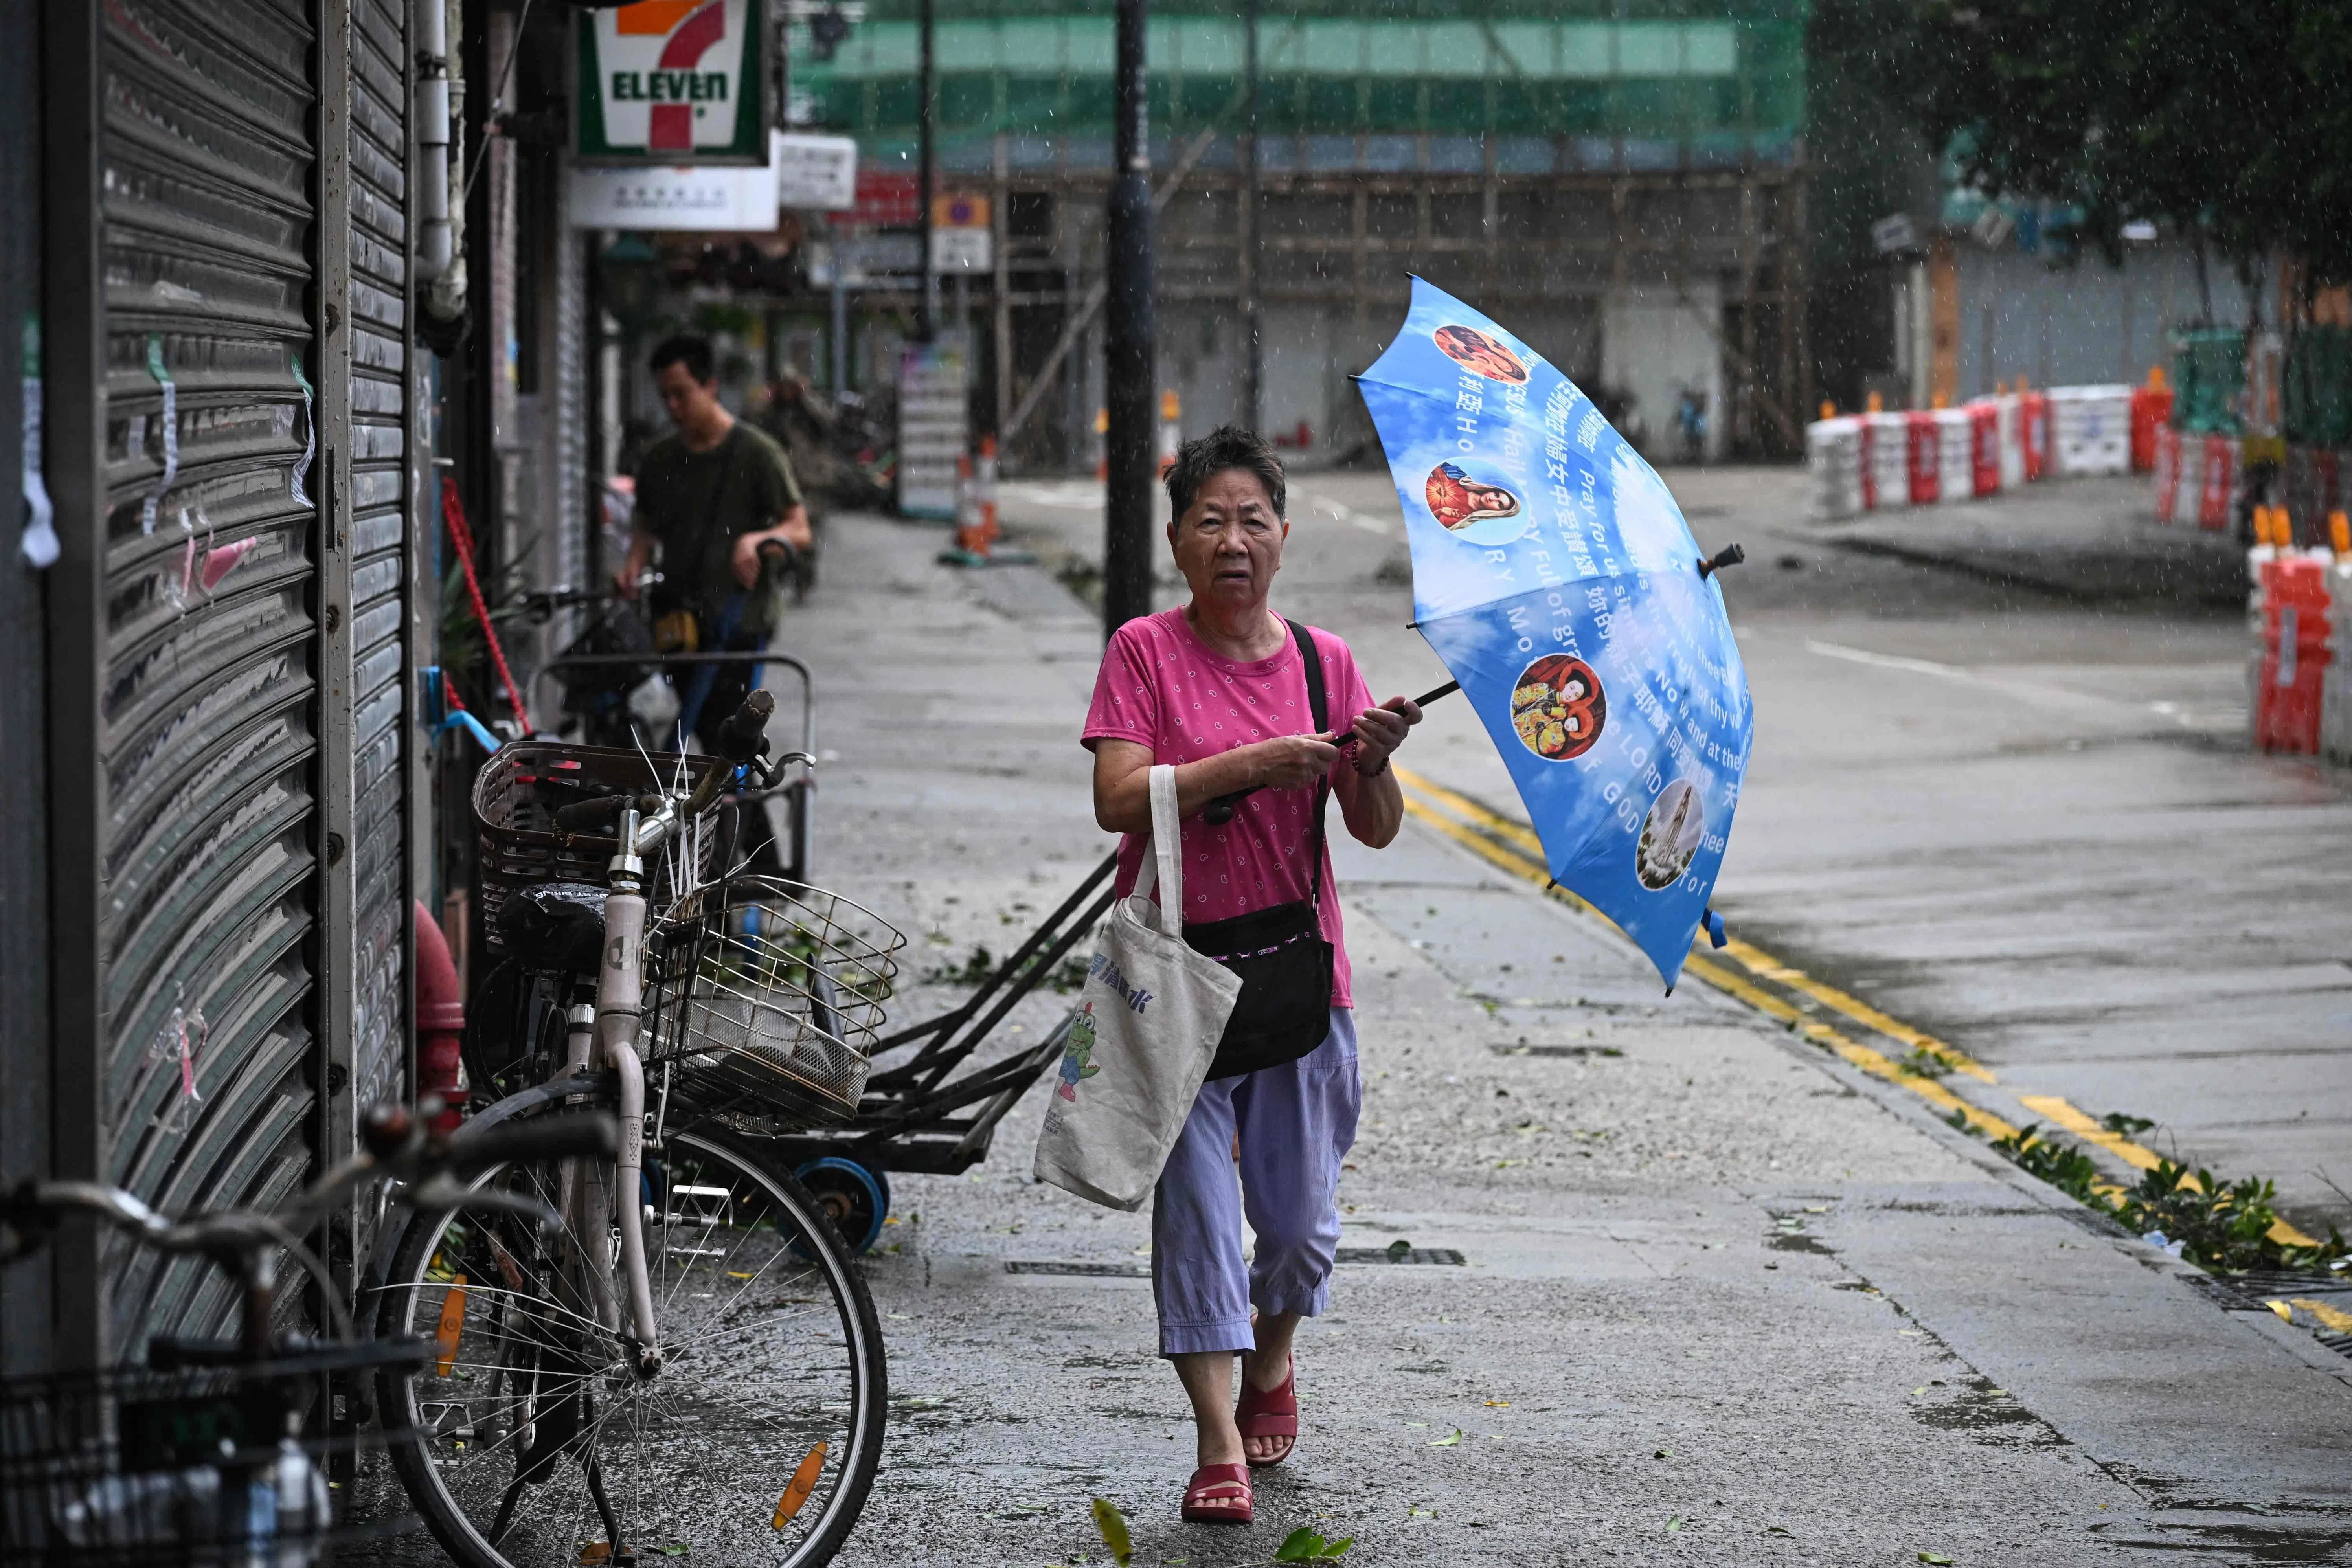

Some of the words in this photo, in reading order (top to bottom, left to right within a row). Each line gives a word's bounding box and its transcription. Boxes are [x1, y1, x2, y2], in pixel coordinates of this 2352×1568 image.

[1547, 593, 1572, 617] of
[1579, 468, 1597, 518] Pray
[1589, 521, 1610, 553] for
[1604, 558, 1620, 578] us
[1687, 718, 1707, 750] and
[1708, 741, 1720, 762] at
[1722, 747, 1740, 771] the
[1710, 697, 1727, 729] thy
[1618, 733, 1662, 795] LORD
[1603, 781, 1639, 834] GOD
[1702, 824, 1725, 854] hee
[1679, 867, 1707, 896] for
